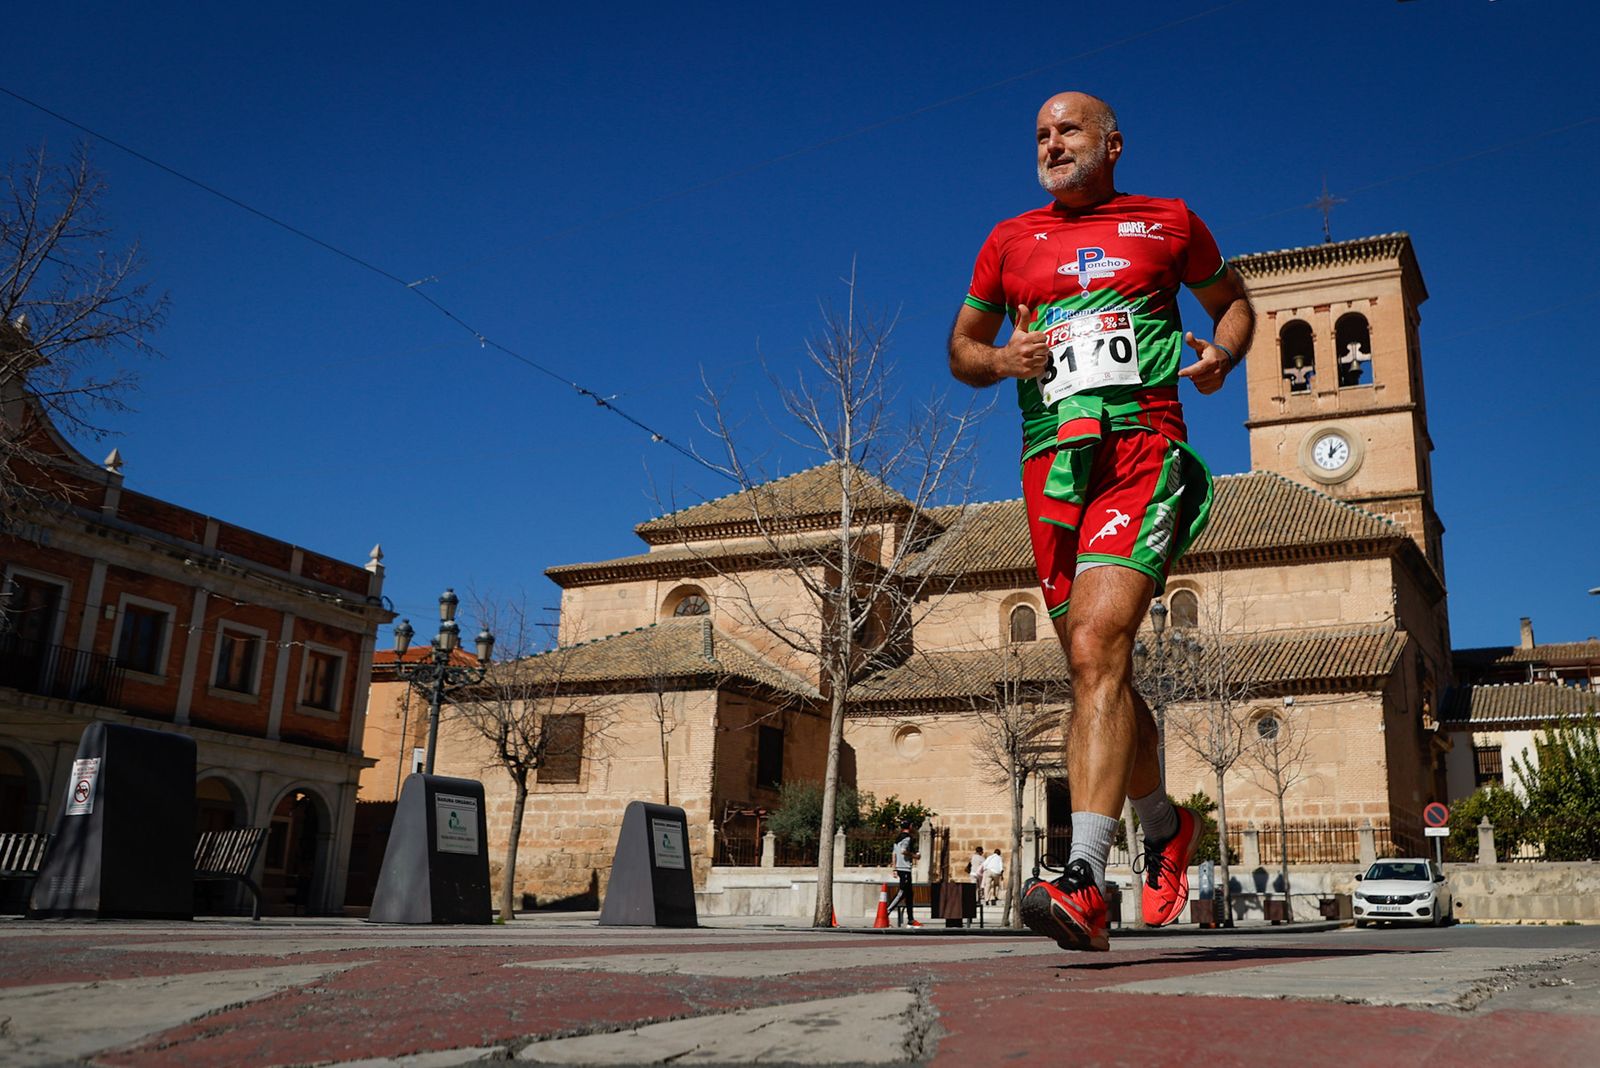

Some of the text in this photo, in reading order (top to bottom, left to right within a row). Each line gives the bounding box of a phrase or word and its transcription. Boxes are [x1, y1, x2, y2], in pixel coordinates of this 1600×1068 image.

[1118, 221, 1147, 234] ATARFE
[1077, 247, 1121, 272] Poncho
[1051, 321, 1104, 345] FONO
